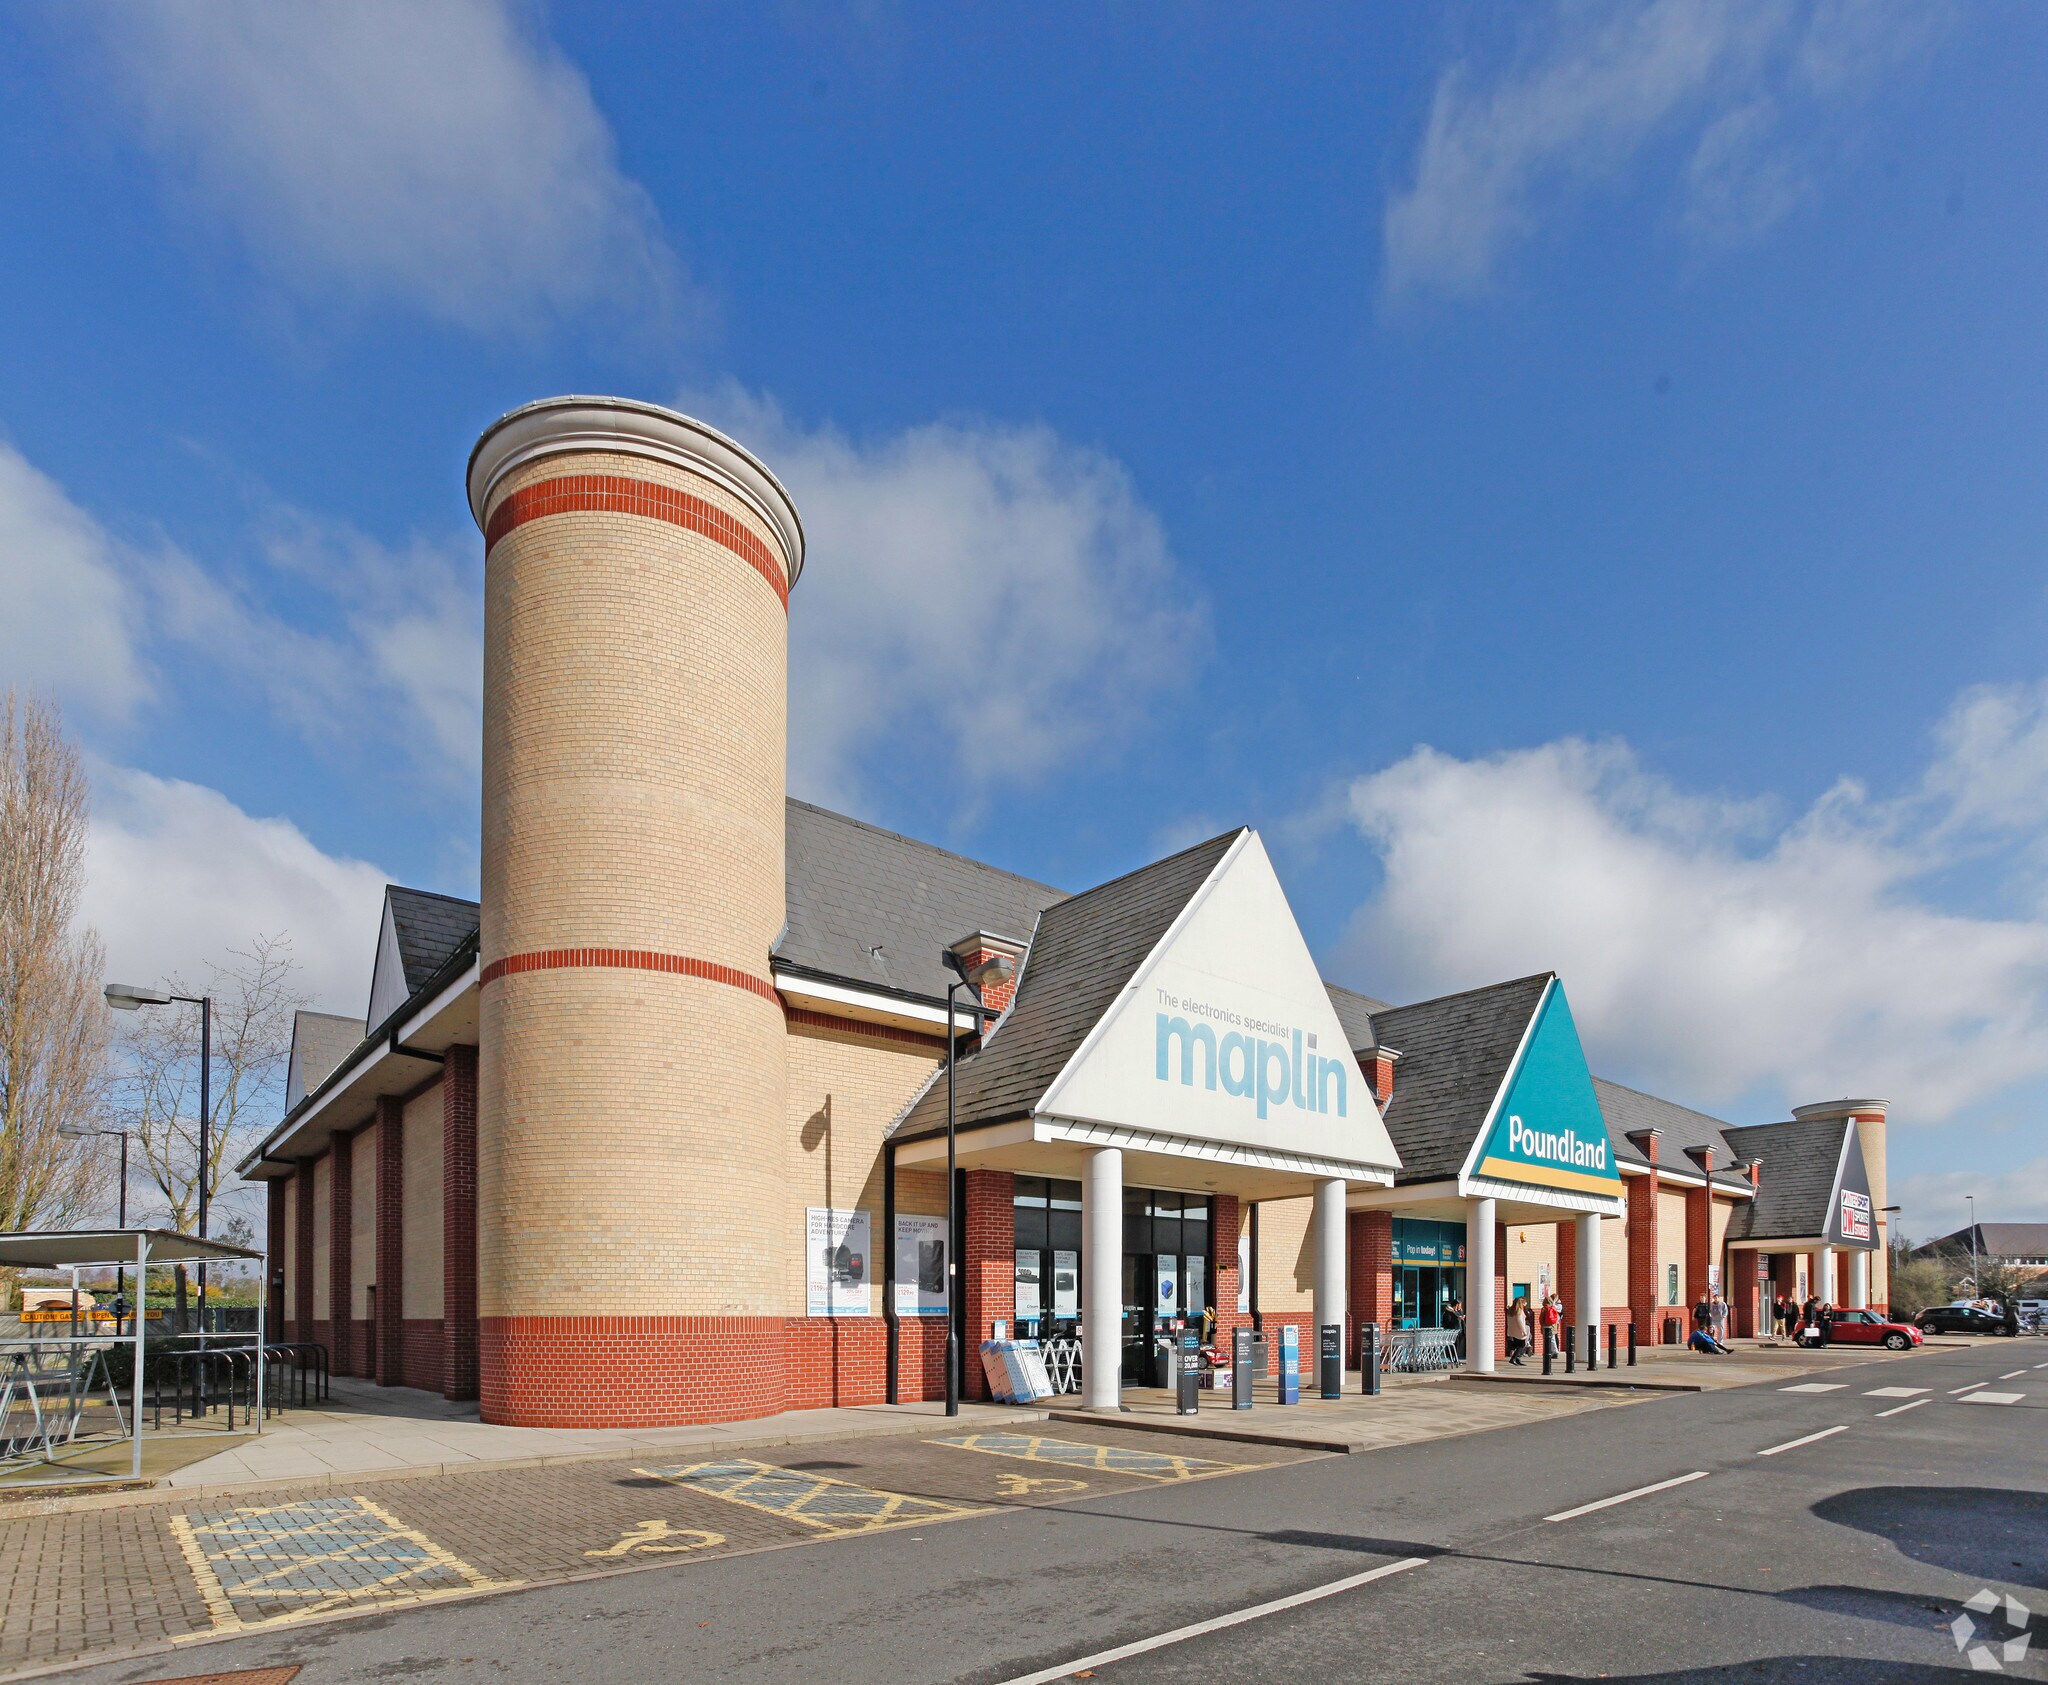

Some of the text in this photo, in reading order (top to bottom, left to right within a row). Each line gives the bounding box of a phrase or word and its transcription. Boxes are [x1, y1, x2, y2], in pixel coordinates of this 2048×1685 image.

[1156, 988, 1290, 1039] The electronics specialist
[1155, 1012, 1347, 1120] maplin
[1509, 1115, 1606, 1170] Poundland
[840, 1217, 864, 1225] CAMERA
[1843, 1208, 1853, 1233] DW
[1854, 1223, 1868, 1238] STORES
[1407, 1245, 1415, 1255] Pop
[1416, 1245, 1420, 1253] in
[1421, 1246, 1435, 1256] today!
